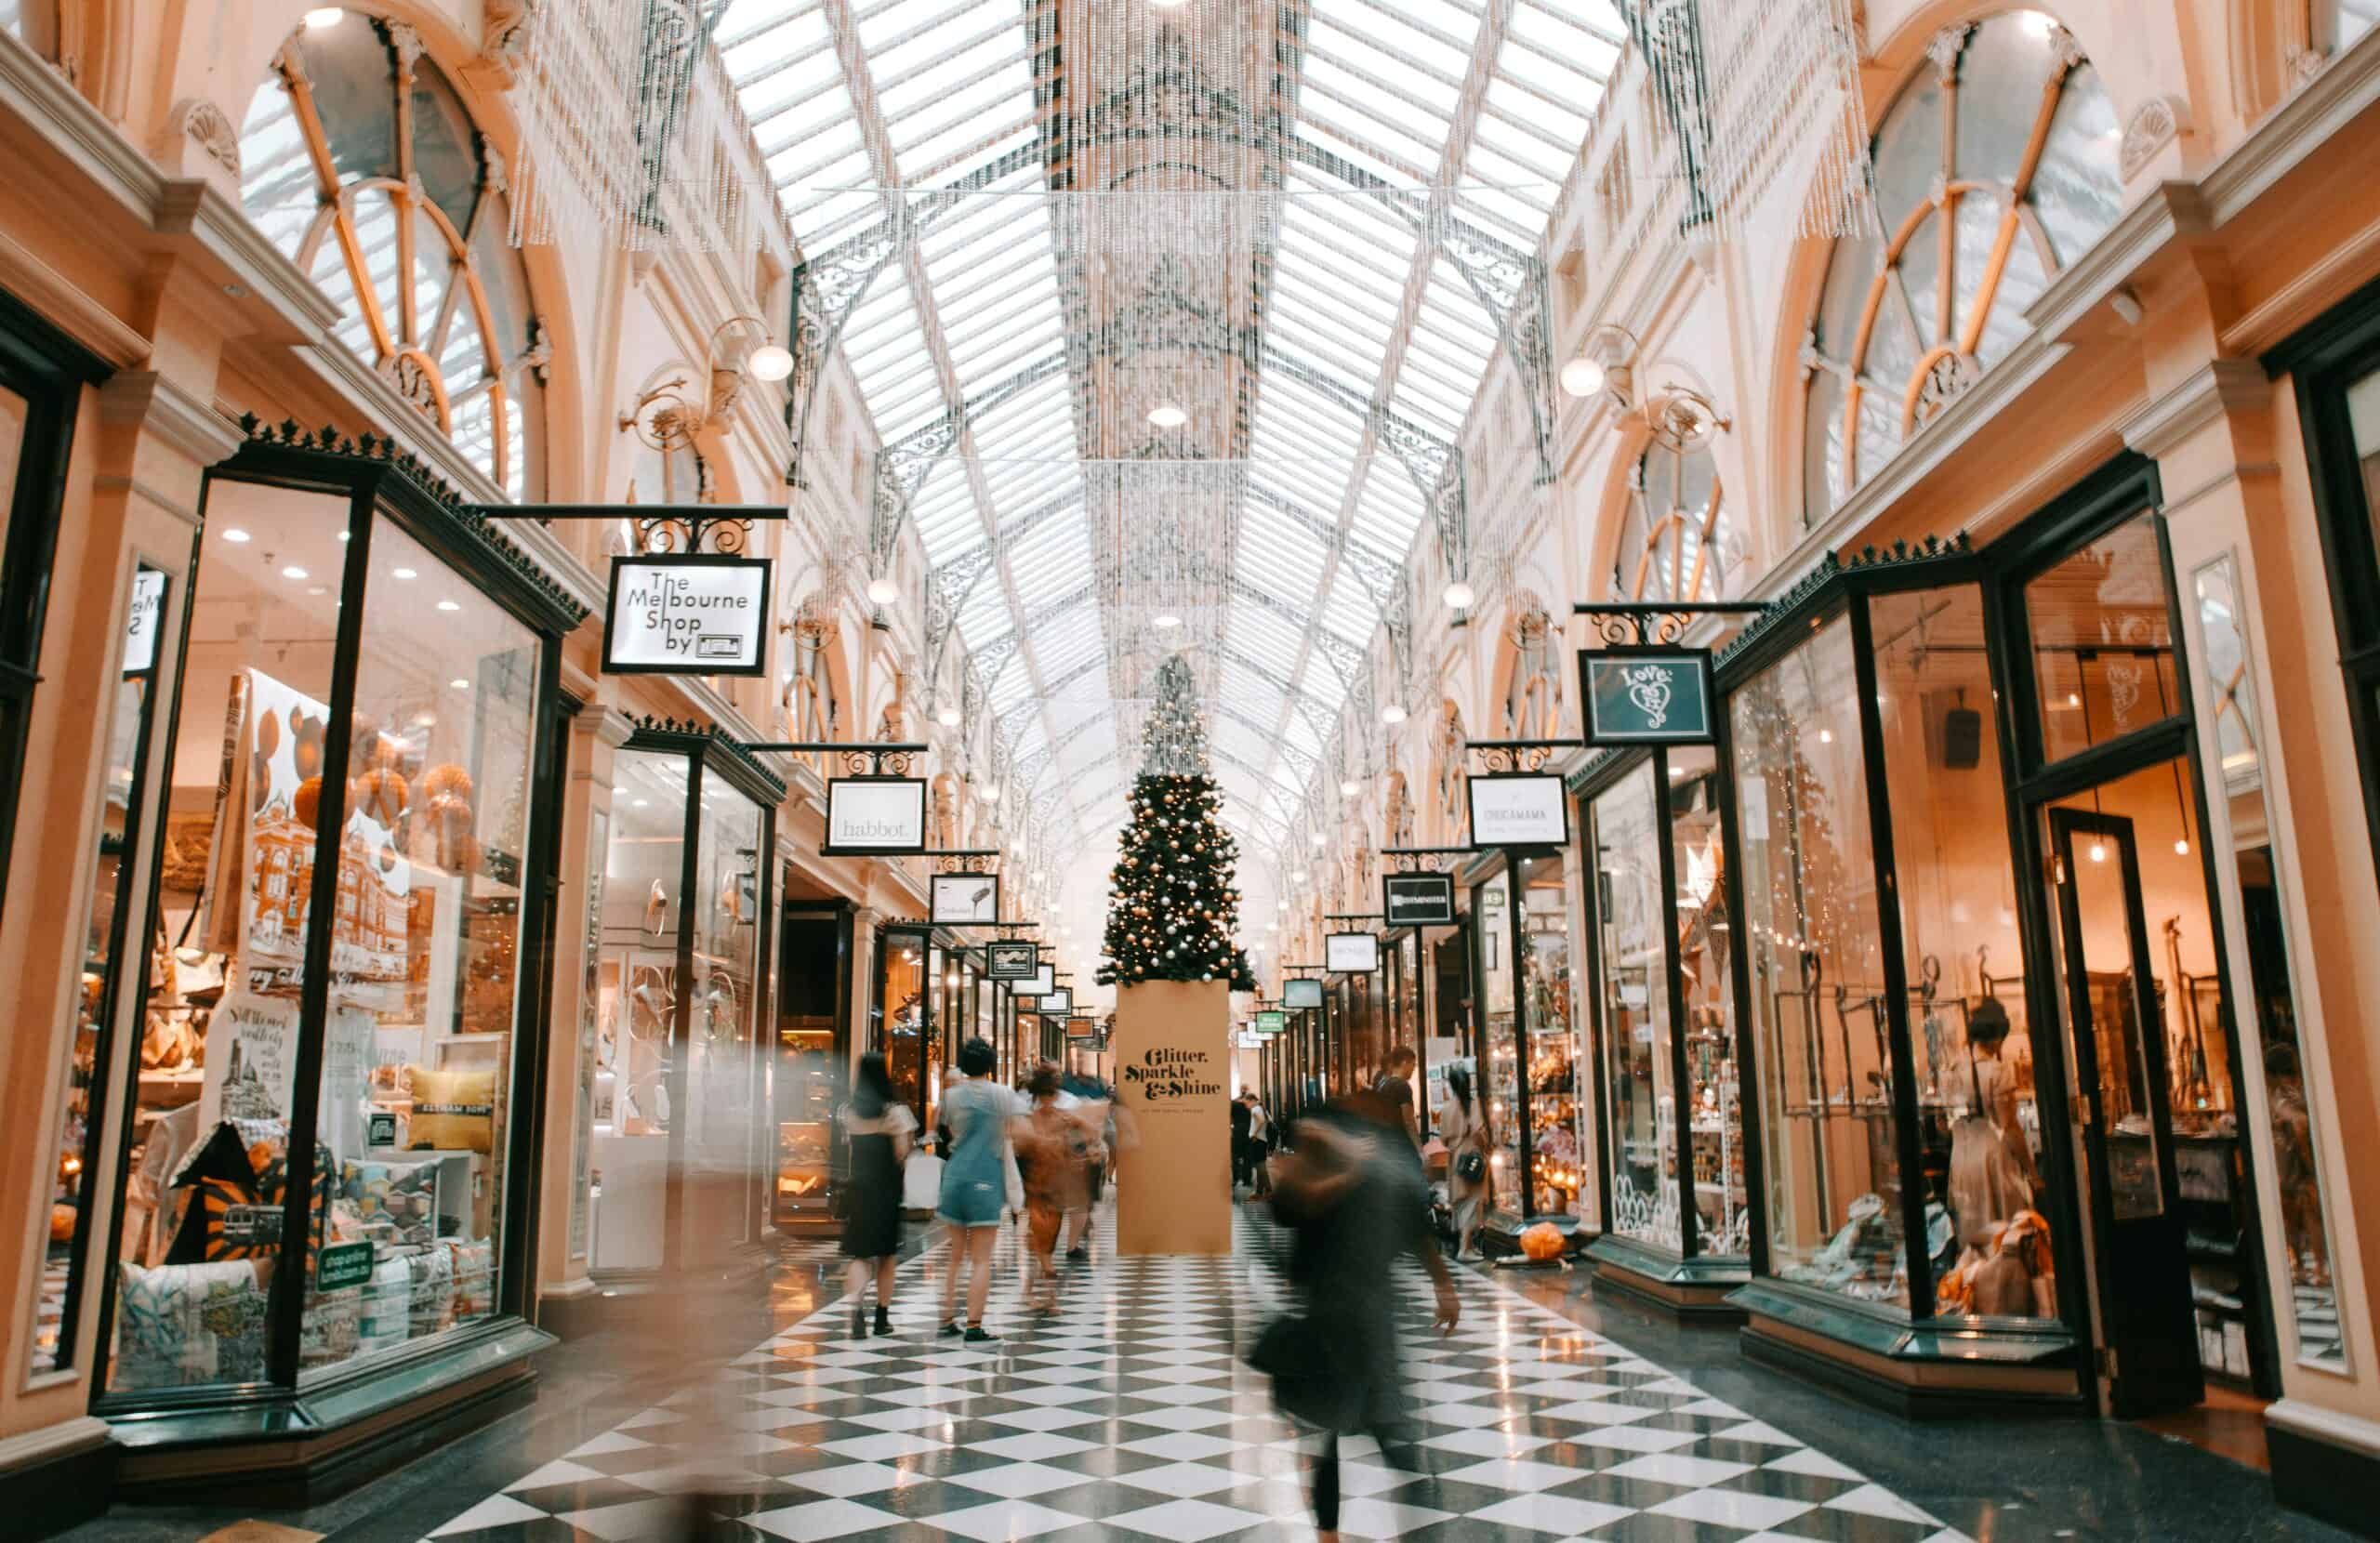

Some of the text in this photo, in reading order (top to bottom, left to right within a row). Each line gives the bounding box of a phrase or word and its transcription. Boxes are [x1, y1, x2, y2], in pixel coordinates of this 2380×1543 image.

[652, 573, 690, 590] The
[628, 588, 748, 609] Melbourne
[647, 611, 701, 635] Shop
[666, 633, 692, 654] by
[1125, 1064, 1195, 1083] Sparkle
